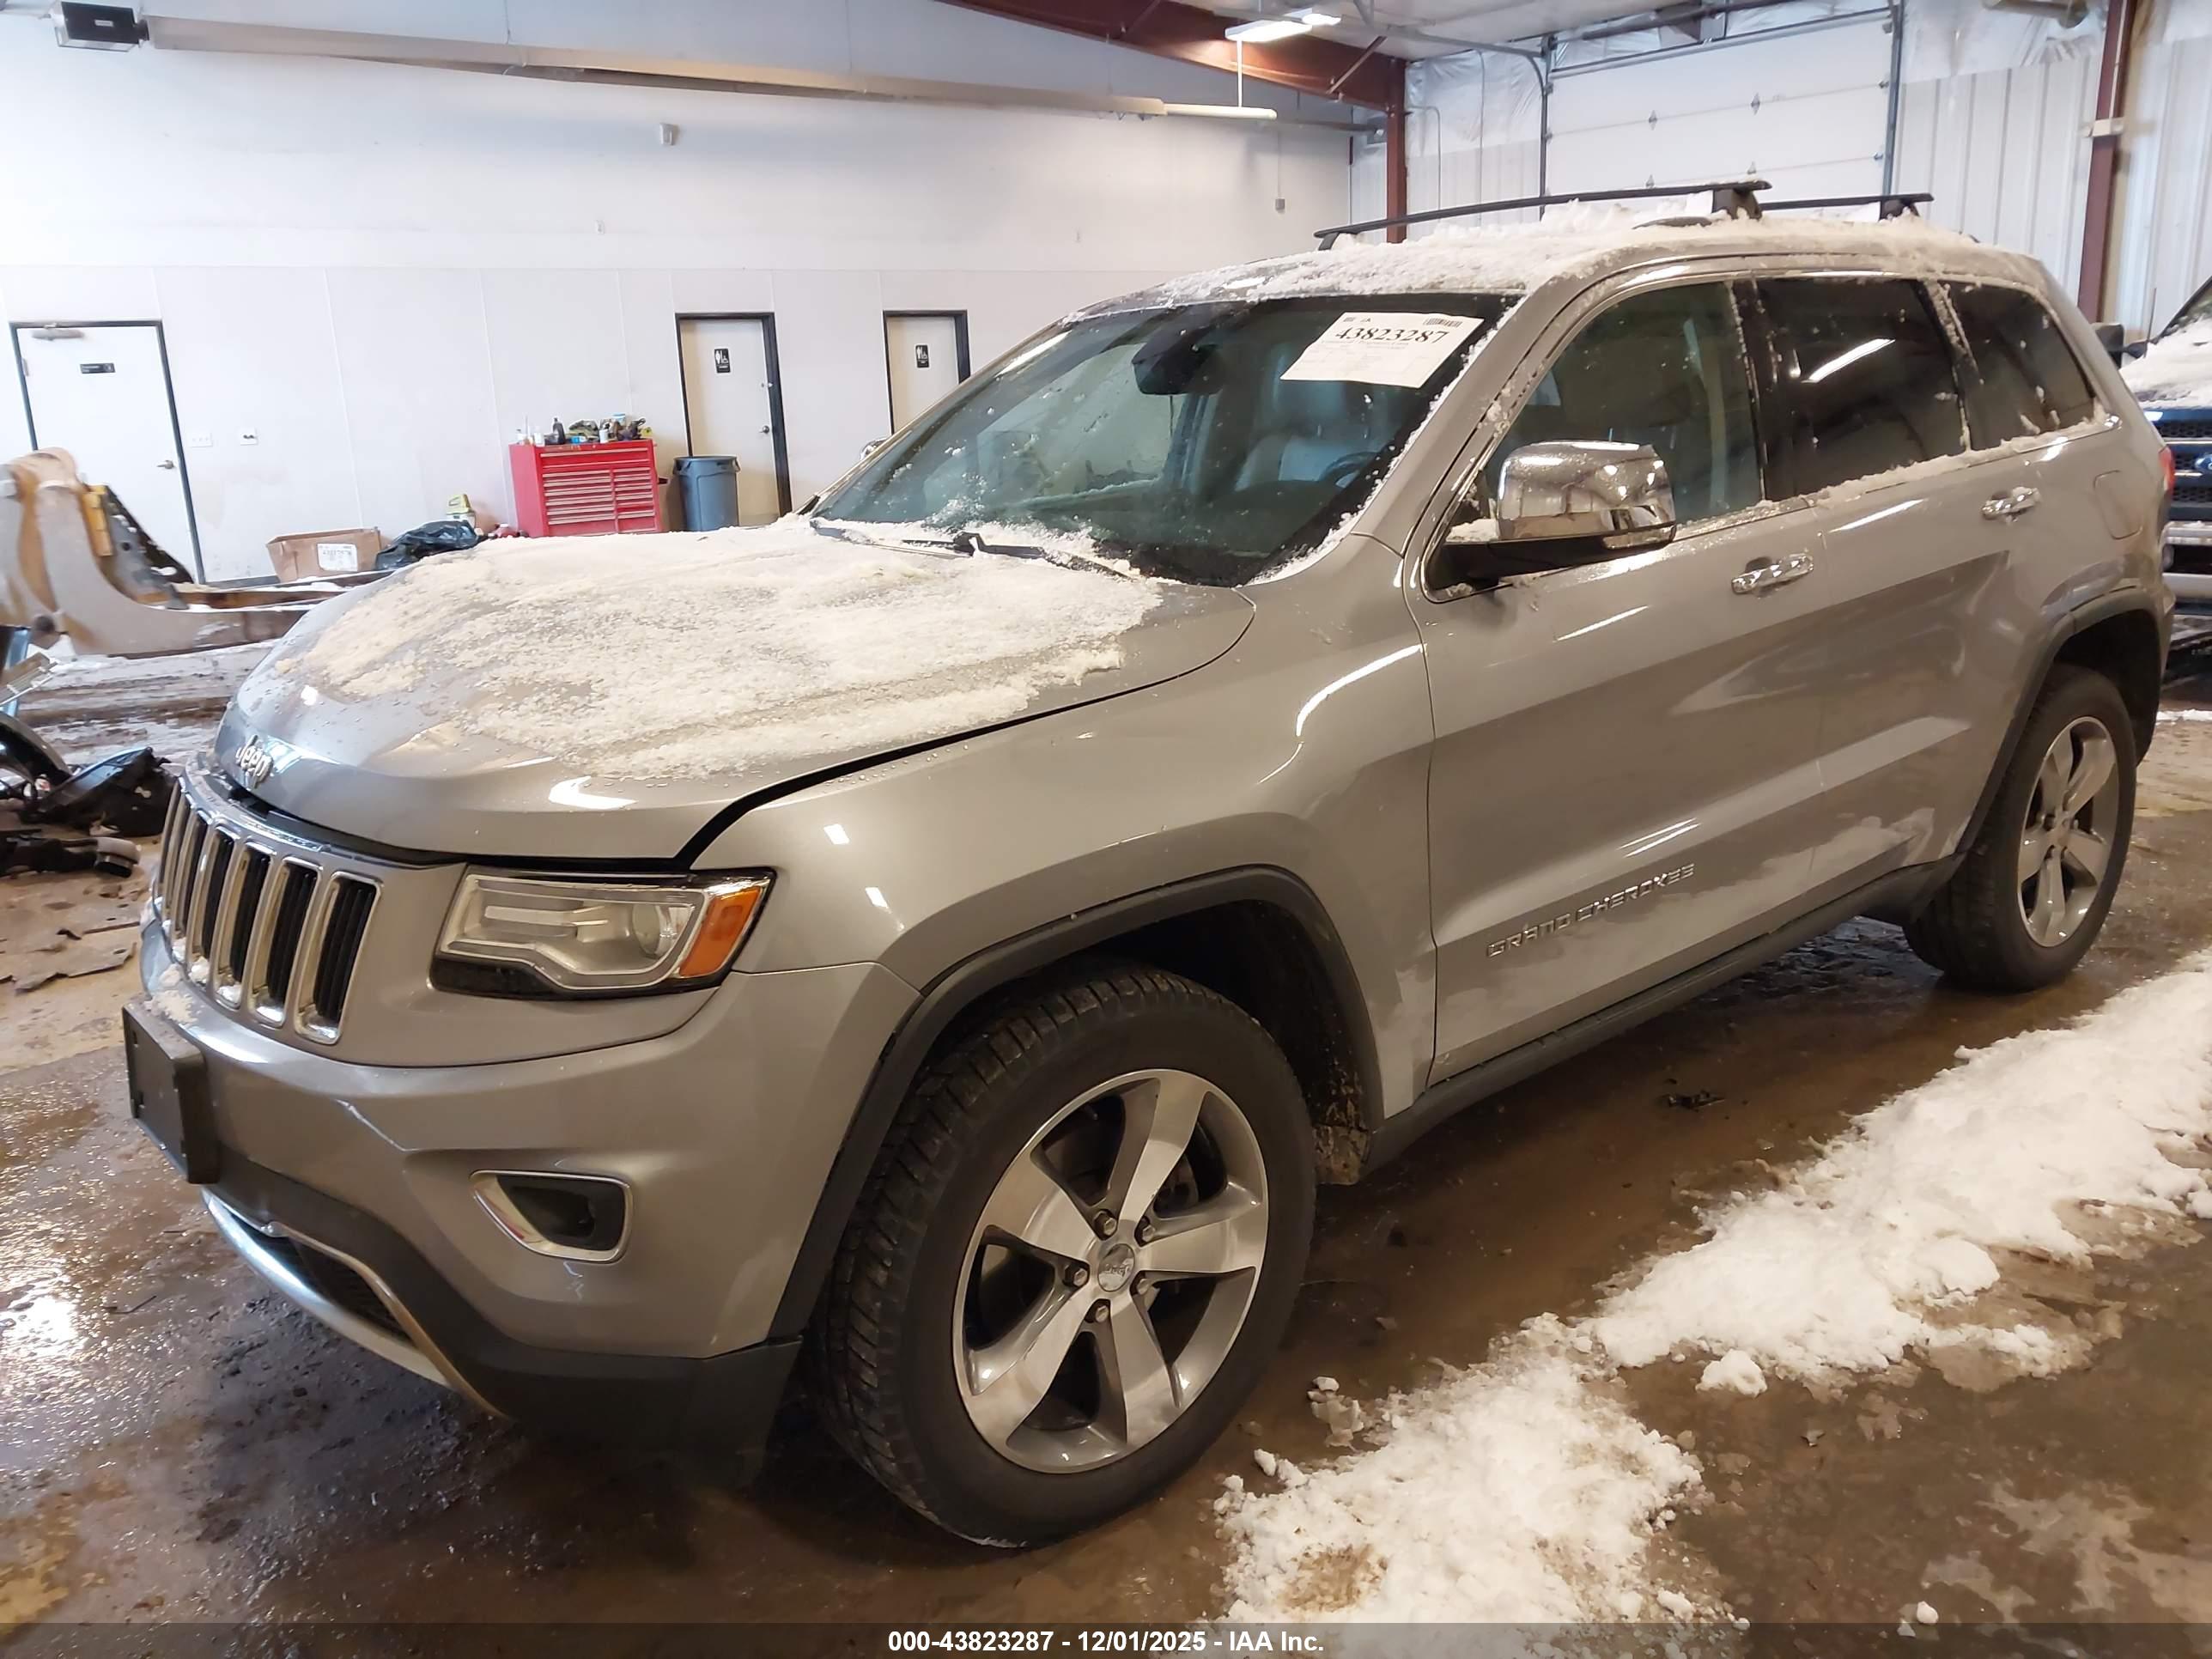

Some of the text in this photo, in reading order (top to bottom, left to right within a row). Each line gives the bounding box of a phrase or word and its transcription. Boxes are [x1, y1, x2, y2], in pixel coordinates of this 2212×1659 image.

[1335, 327, 1449, 343] 43823287
[235, 734, 274, 789] Jeep
[1486, 862, 1696, 958] GRAND CHEROKEE
